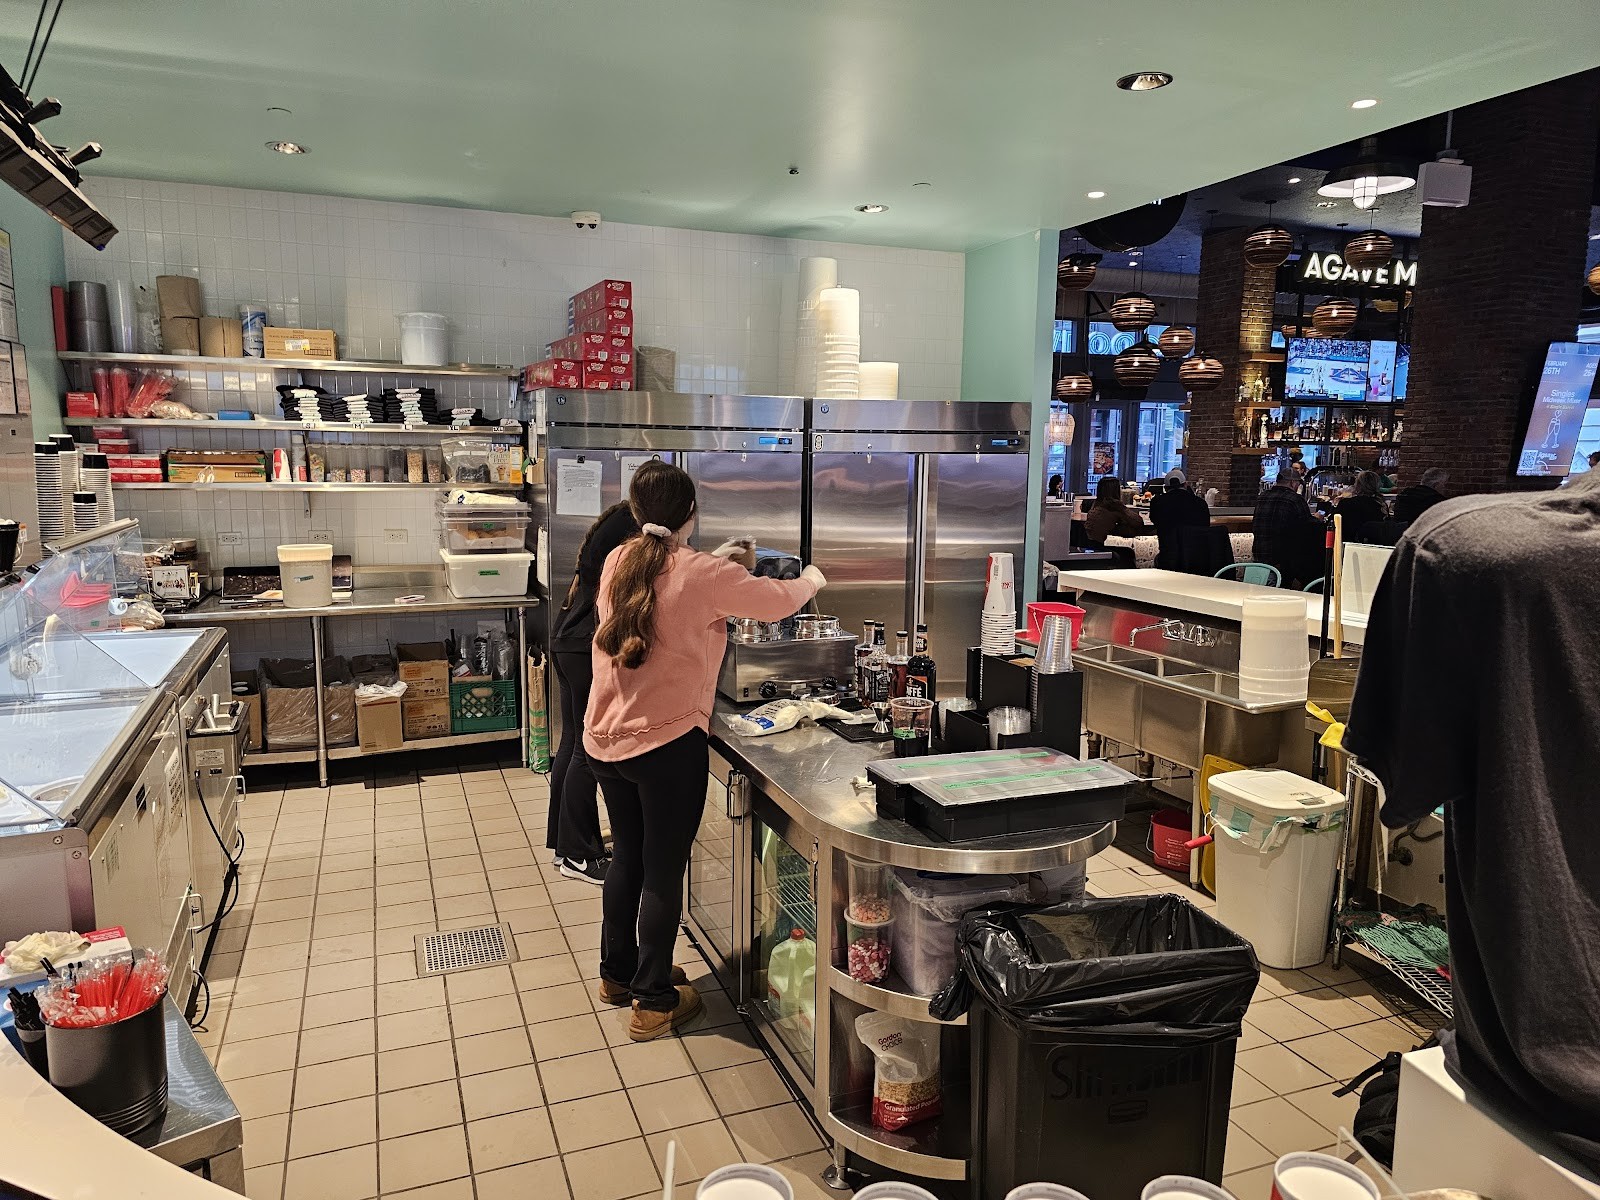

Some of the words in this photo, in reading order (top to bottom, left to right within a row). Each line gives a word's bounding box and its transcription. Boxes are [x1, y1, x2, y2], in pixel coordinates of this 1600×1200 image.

[1303, 252, 1389, 285] AGAVE
[1551, 389, 1576, 399] Singles
[878, 1032, 902, 1045] Gordon
[881, 1037, 903, 1052] CHOICE
[884, 1103, 920, 1113] Granulated
